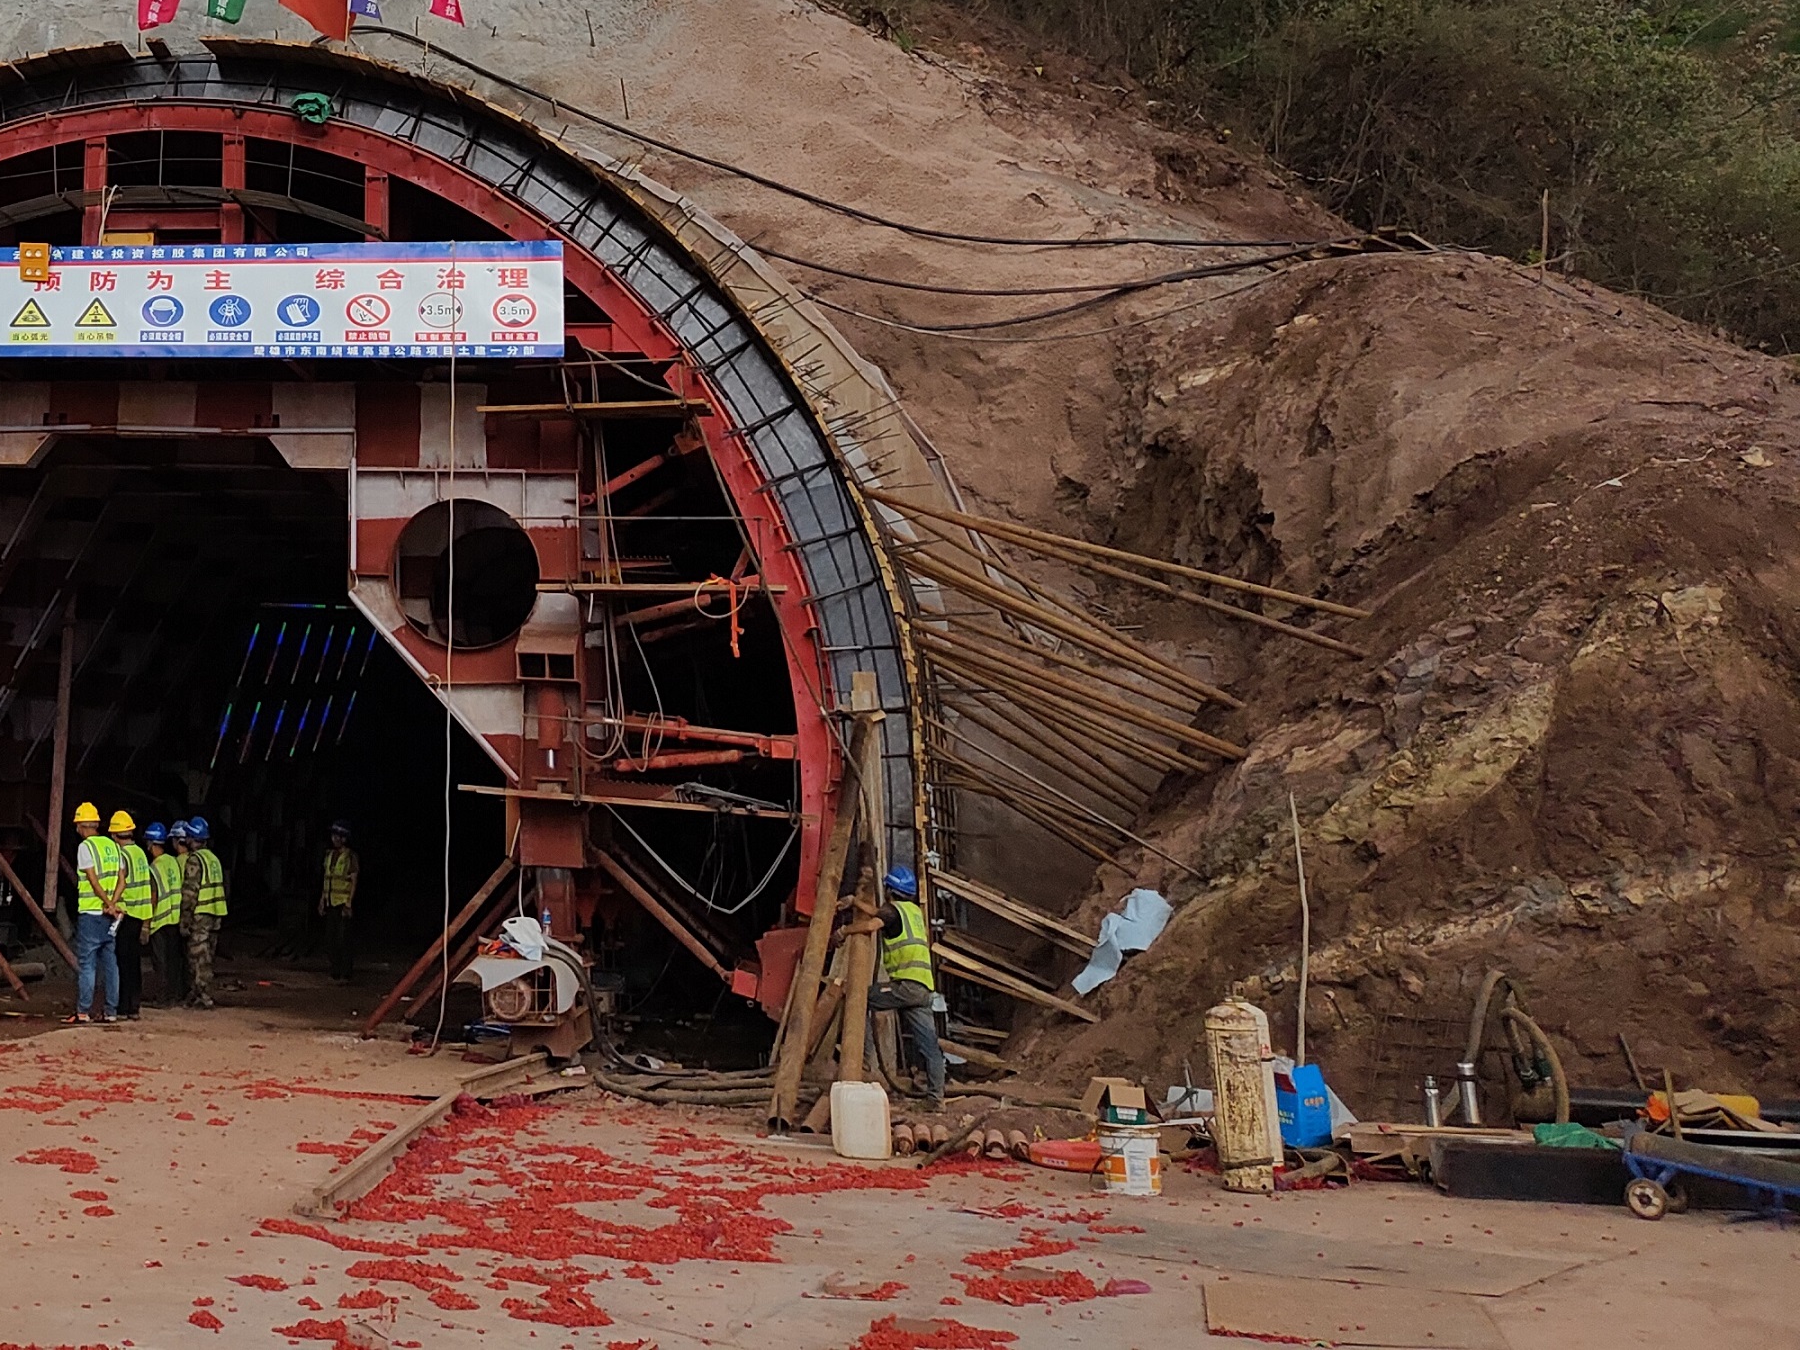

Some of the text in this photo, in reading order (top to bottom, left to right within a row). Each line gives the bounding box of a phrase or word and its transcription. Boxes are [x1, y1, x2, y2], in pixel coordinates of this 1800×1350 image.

[12, 246, 310, 260] 云省建设投资控股集团有限公司
[34, 267, 233, 292] 预防为主
[315, 267, 530, 291] 综合治理
[499, 305, 530, 316] 3.5m
[12, 332, 48, 341] 当心弧光
[78, 332, 114, 341] 当心吊物
[348, 331, 389, 341] 禁止抛物
[416, 332, 464, 342] 限制宽度
[494, 332, 537, 342] 限制高度
[253, 345, 536, 356] 楚雄市东南绕城高速公路项目土建一分部
